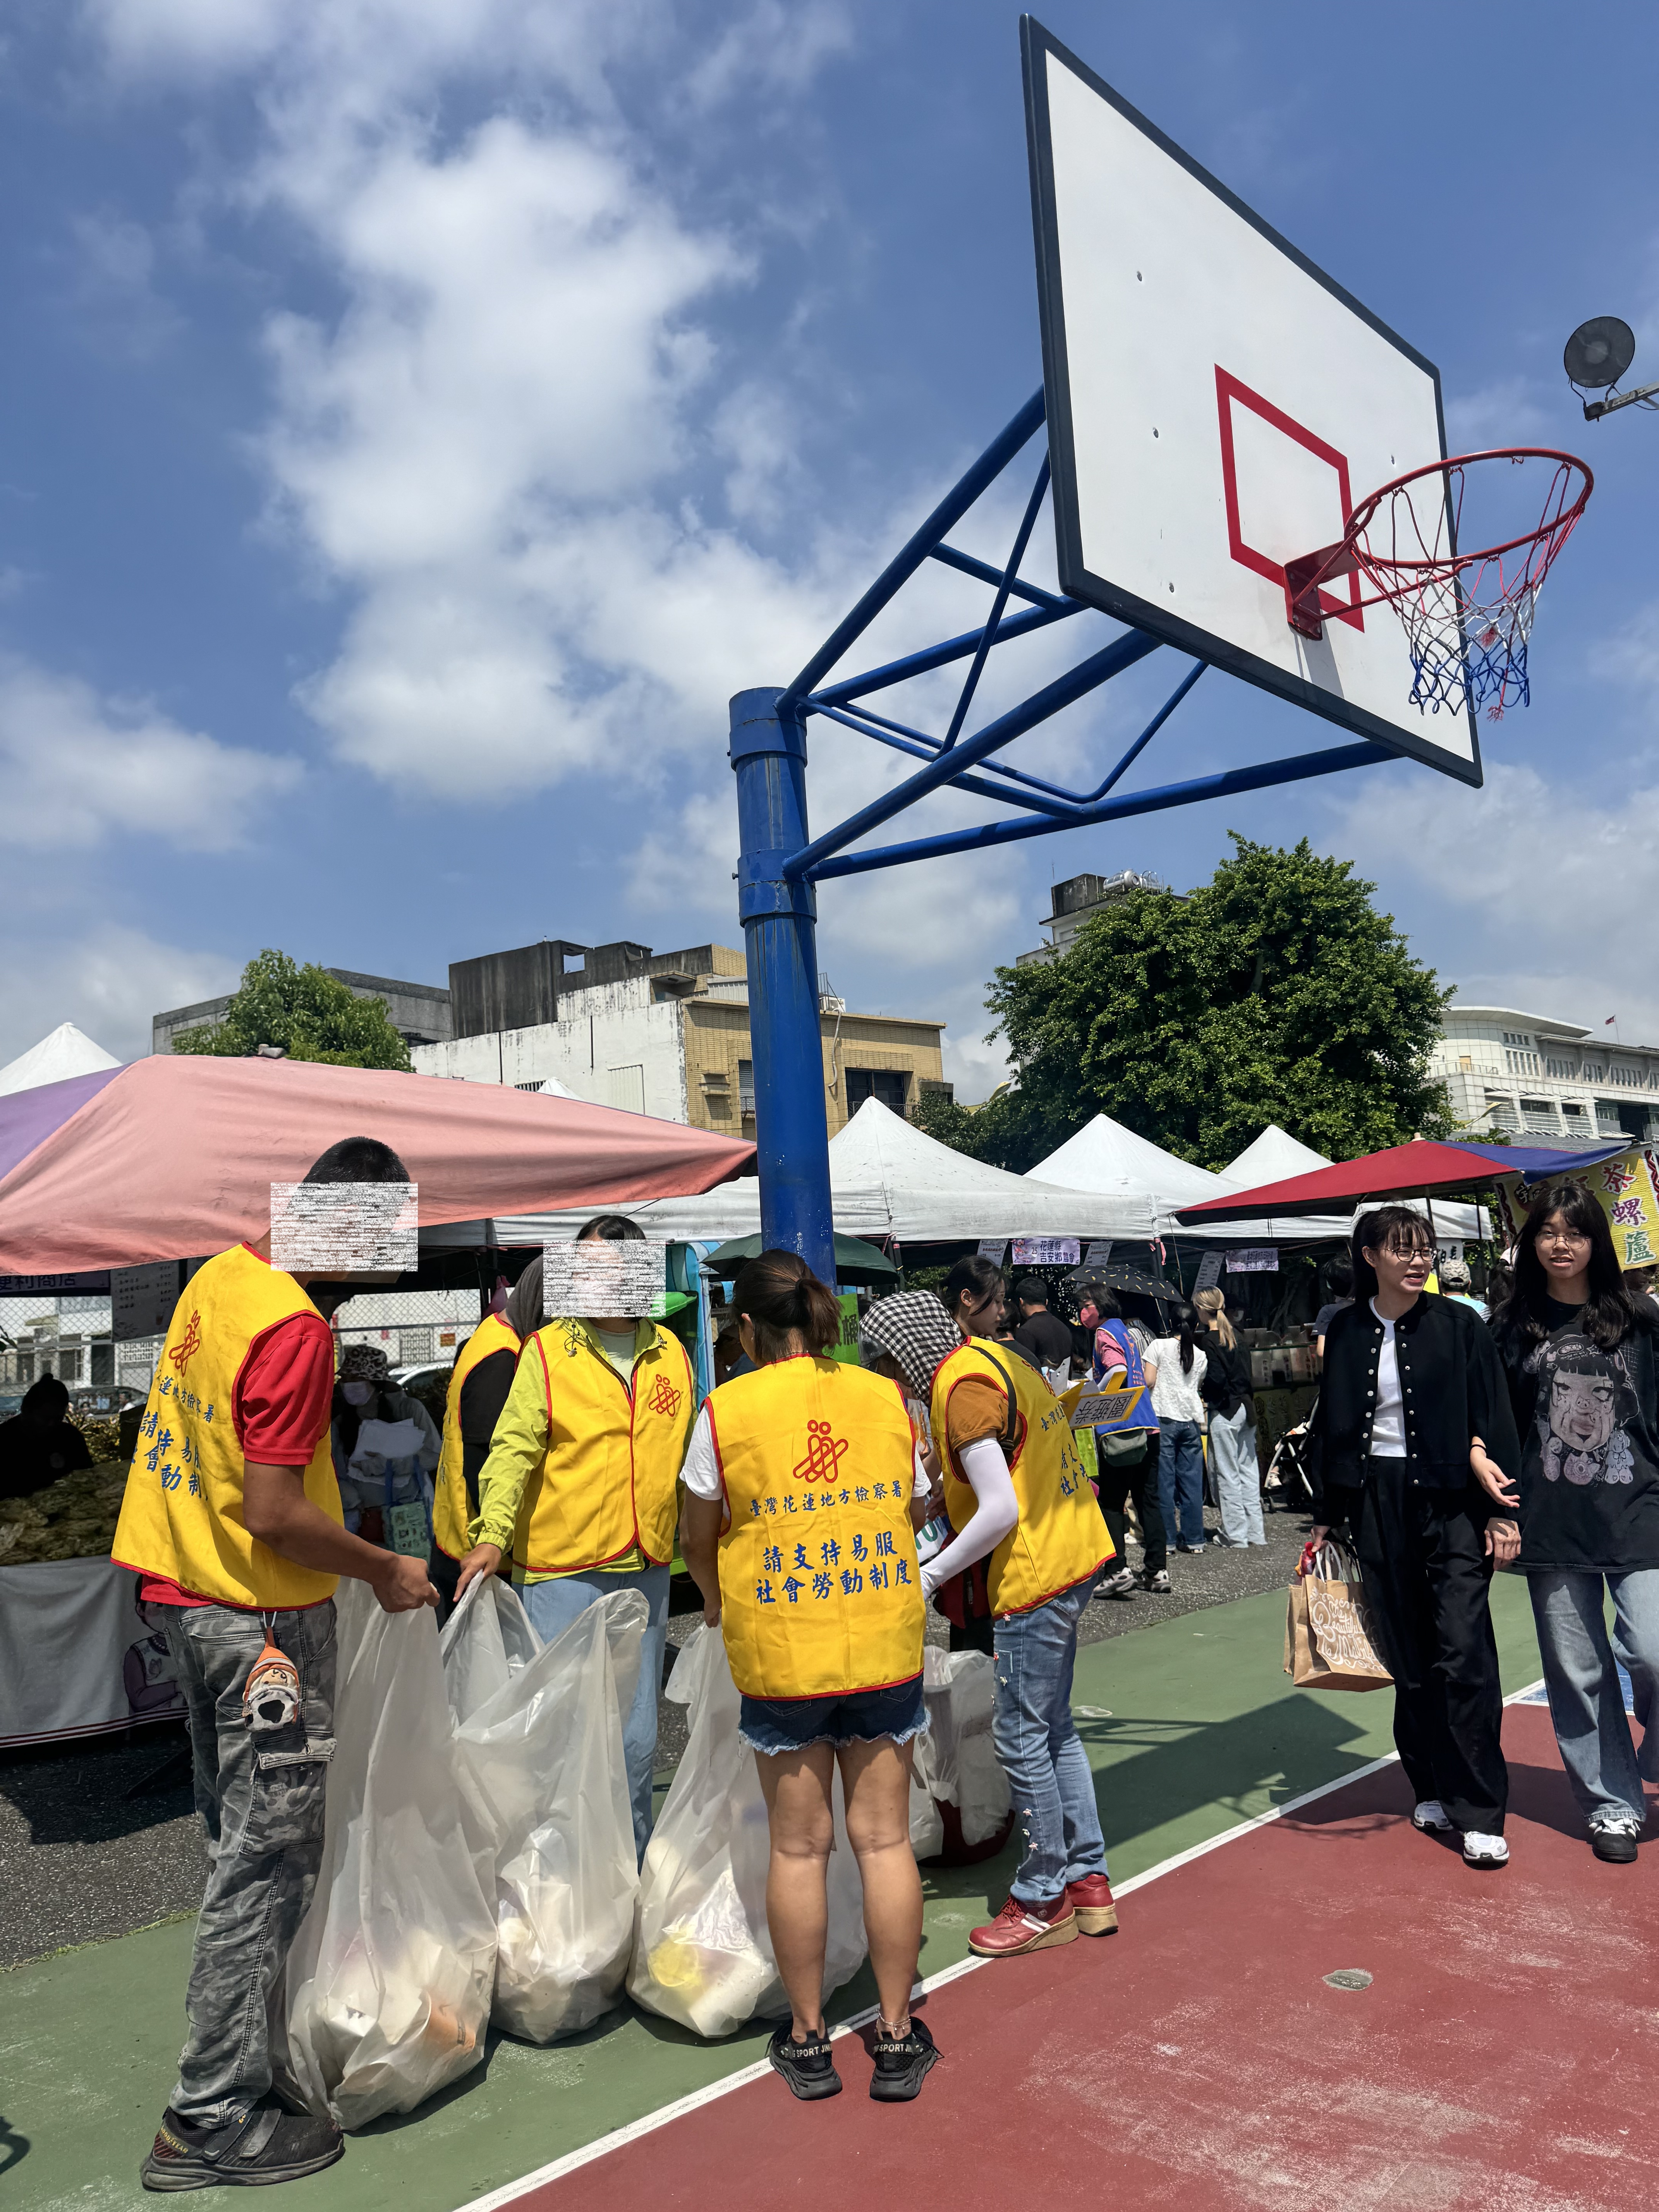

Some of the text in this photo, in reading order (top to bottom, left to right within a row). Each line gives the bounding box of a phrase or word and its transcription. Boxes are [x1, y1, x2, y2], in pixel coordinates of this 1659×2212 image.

[1040, 1240, 1061, 1251] 花蓮縣
[1040, 1252, 1075, 1263] 吉安鄉農會
[750, 1480, 902, 1517] 臺灣花蓮地方檢察署
[763, 1530, 898, 1573] 請支持易服
[756, 1558, 912, 1605] 社會勞動制度
[797, 2046, 819, 2057] SPORT
[879, 2044, 904, 2052] SPORT
